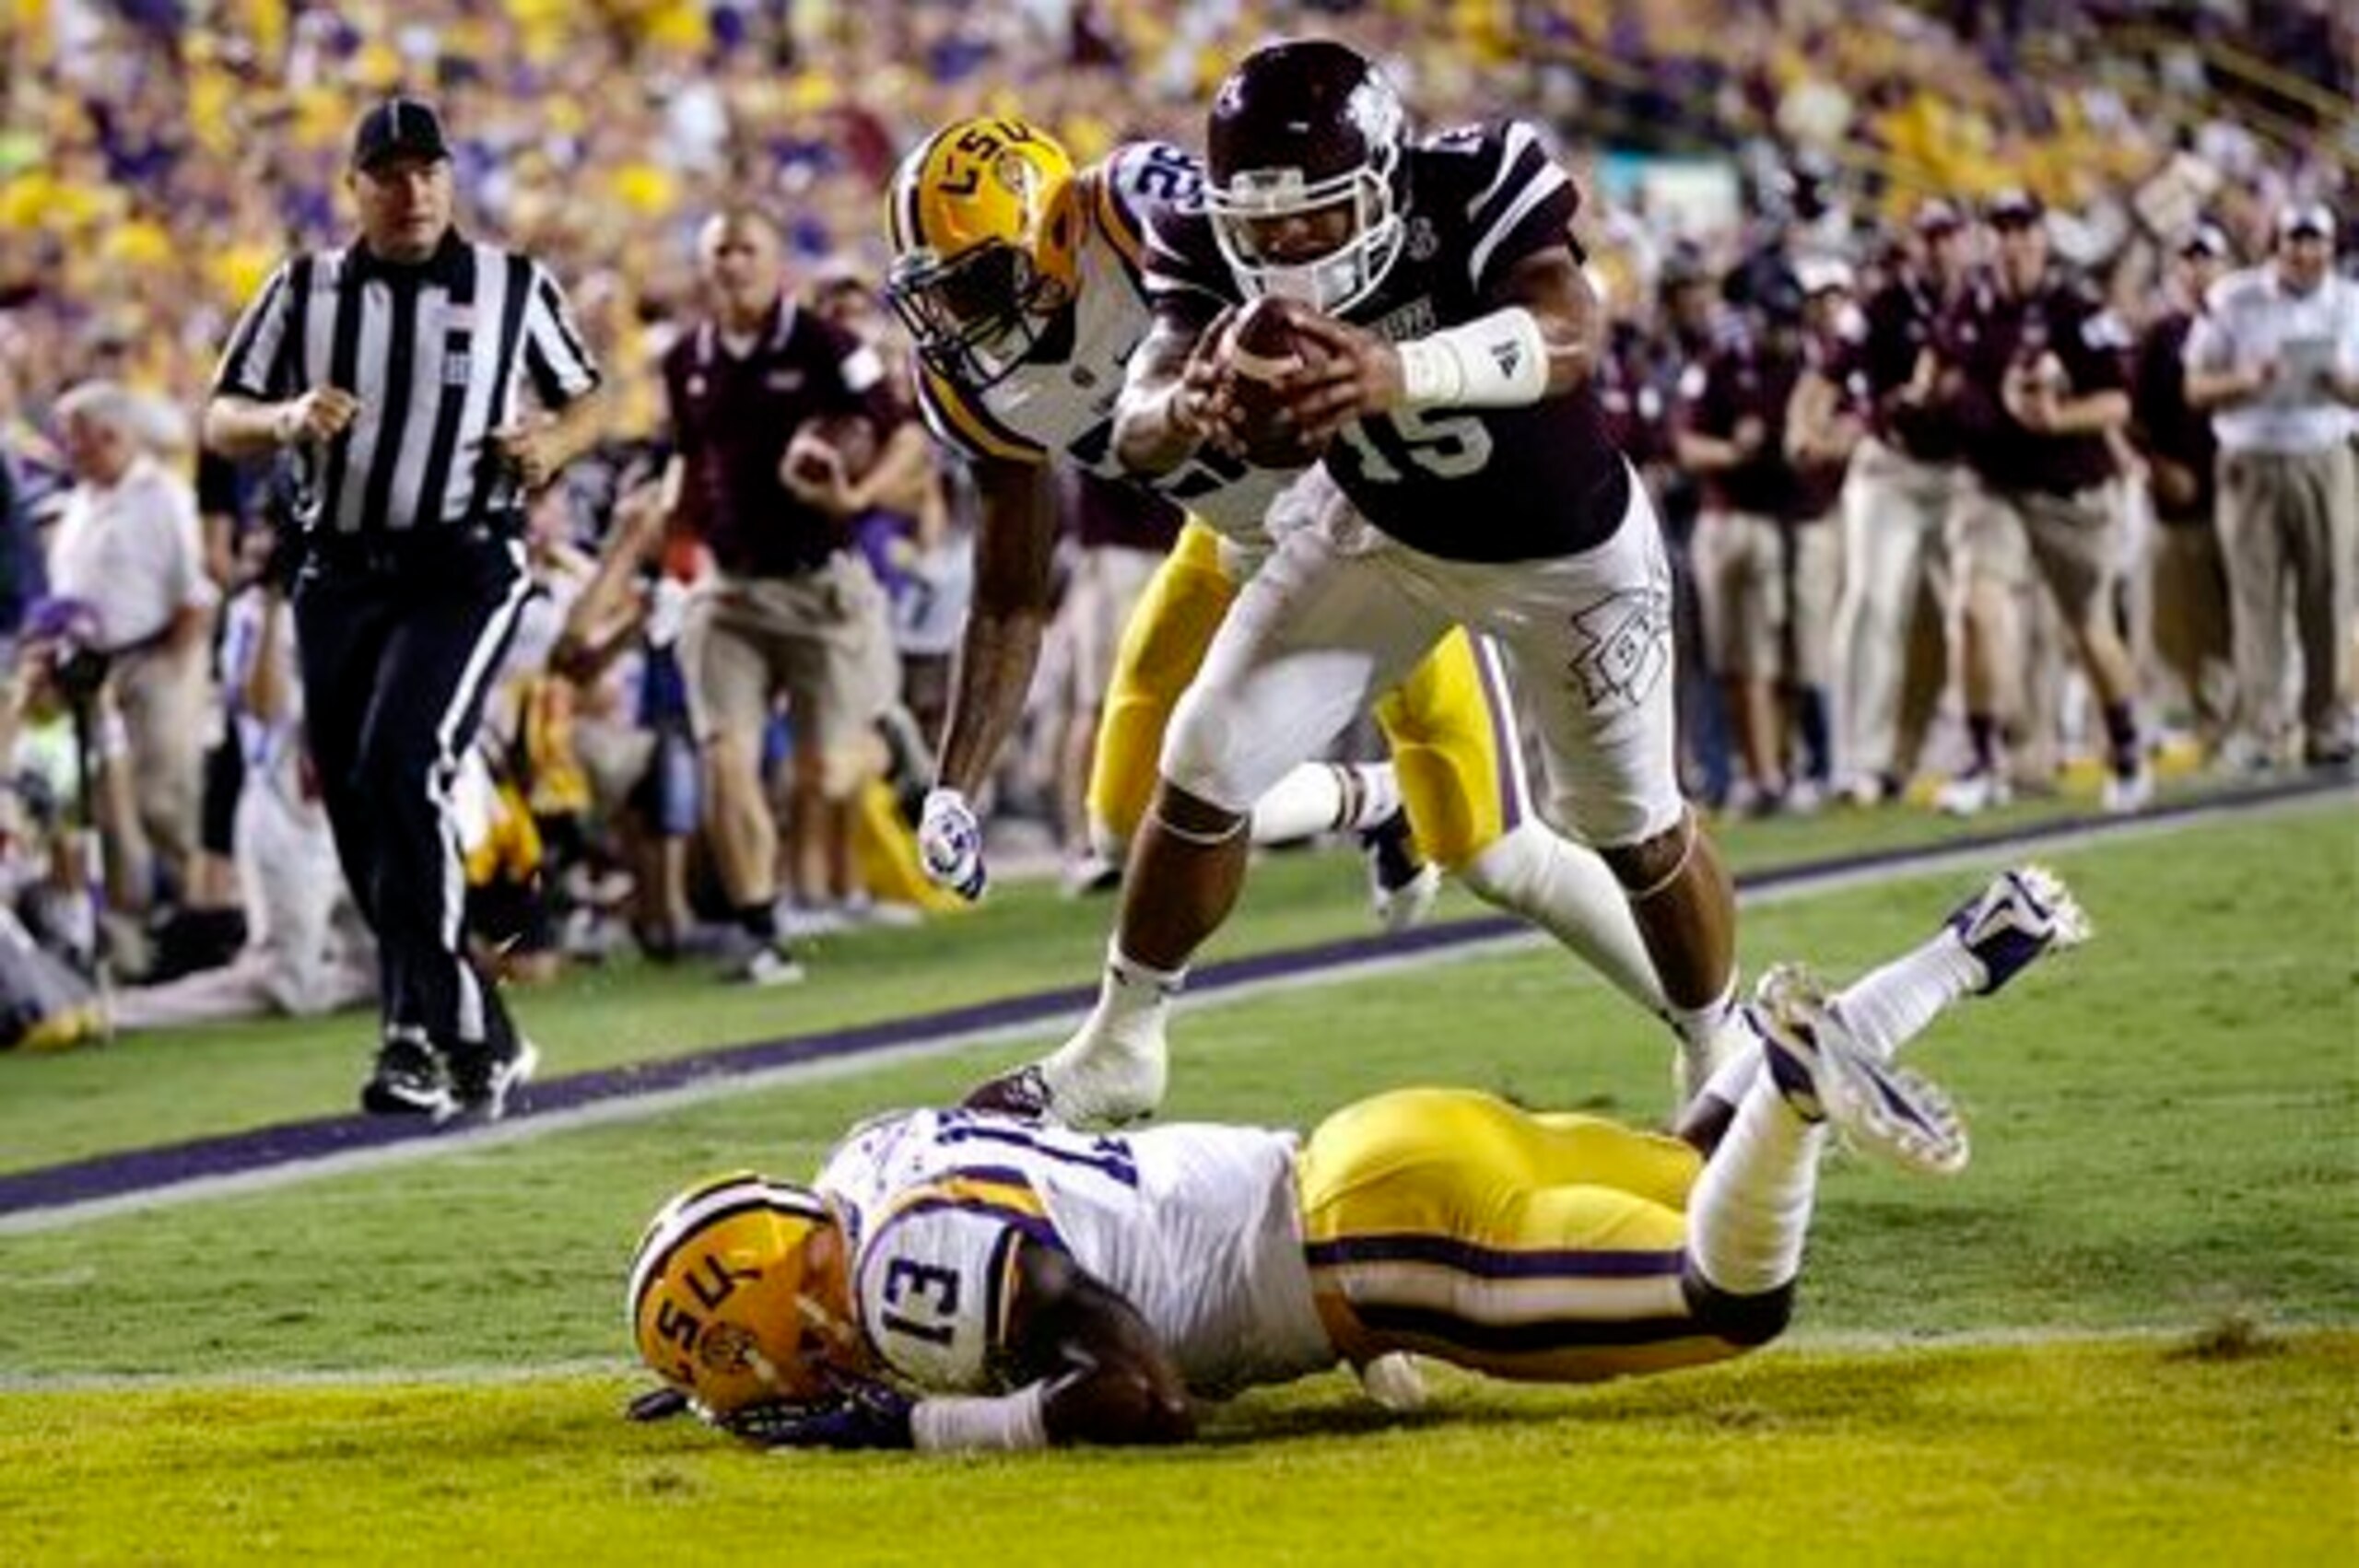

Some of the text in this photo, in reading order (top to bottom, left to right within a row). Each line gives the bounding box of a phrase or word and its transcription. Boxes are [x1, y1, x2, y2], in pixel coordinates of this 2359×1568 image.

[937, 121, 1058, 195] LSU
[1339, 405, 1493, 482] 15
[881, 1257, 959, 1347] 13
